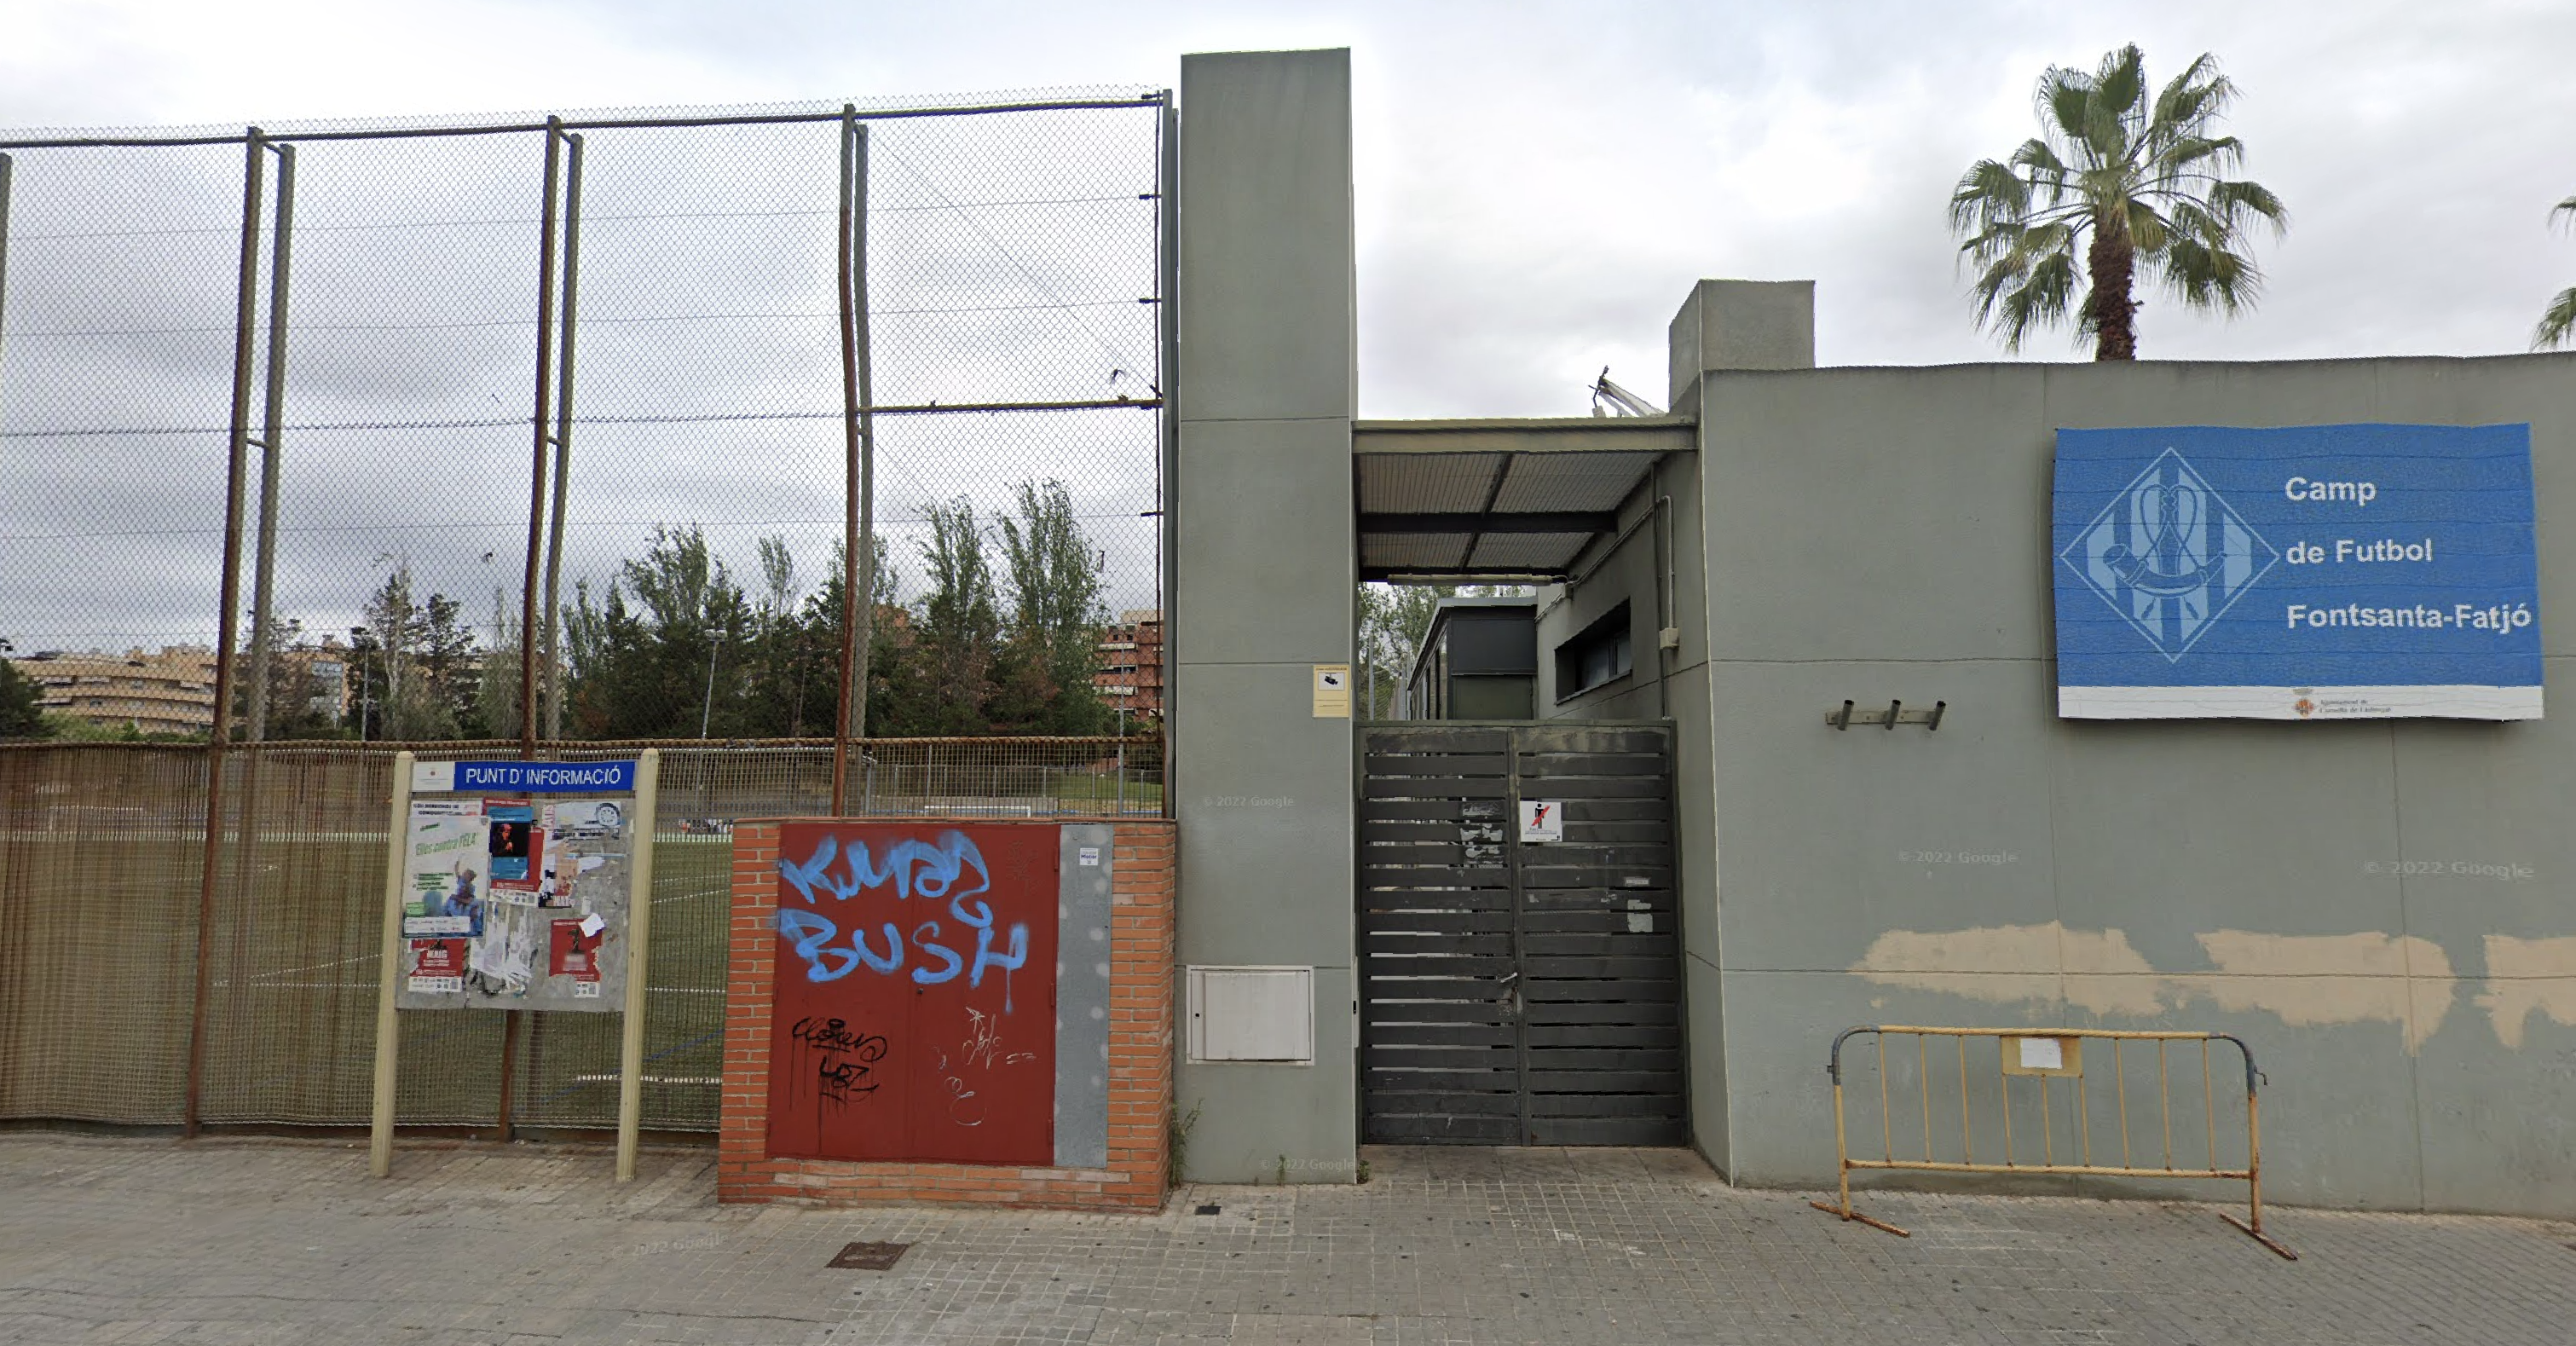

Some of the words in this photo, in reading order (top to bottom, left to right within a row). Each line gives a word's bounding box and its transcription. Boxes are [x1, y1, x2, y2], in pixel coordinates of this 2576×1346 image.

[2284, 477, 2377, 506] Camp
[2285, 541, 2325, 563] de
[2336, 537, 2433, 563] Futbol
[2287, 603, 2532, 634] Fontsanta-Fatjó
[465, 768, 507, 783] PUNT
[526, 765, 621, 785] INFORMACIÓ
[777, 909, 1030, 989] BUSH
